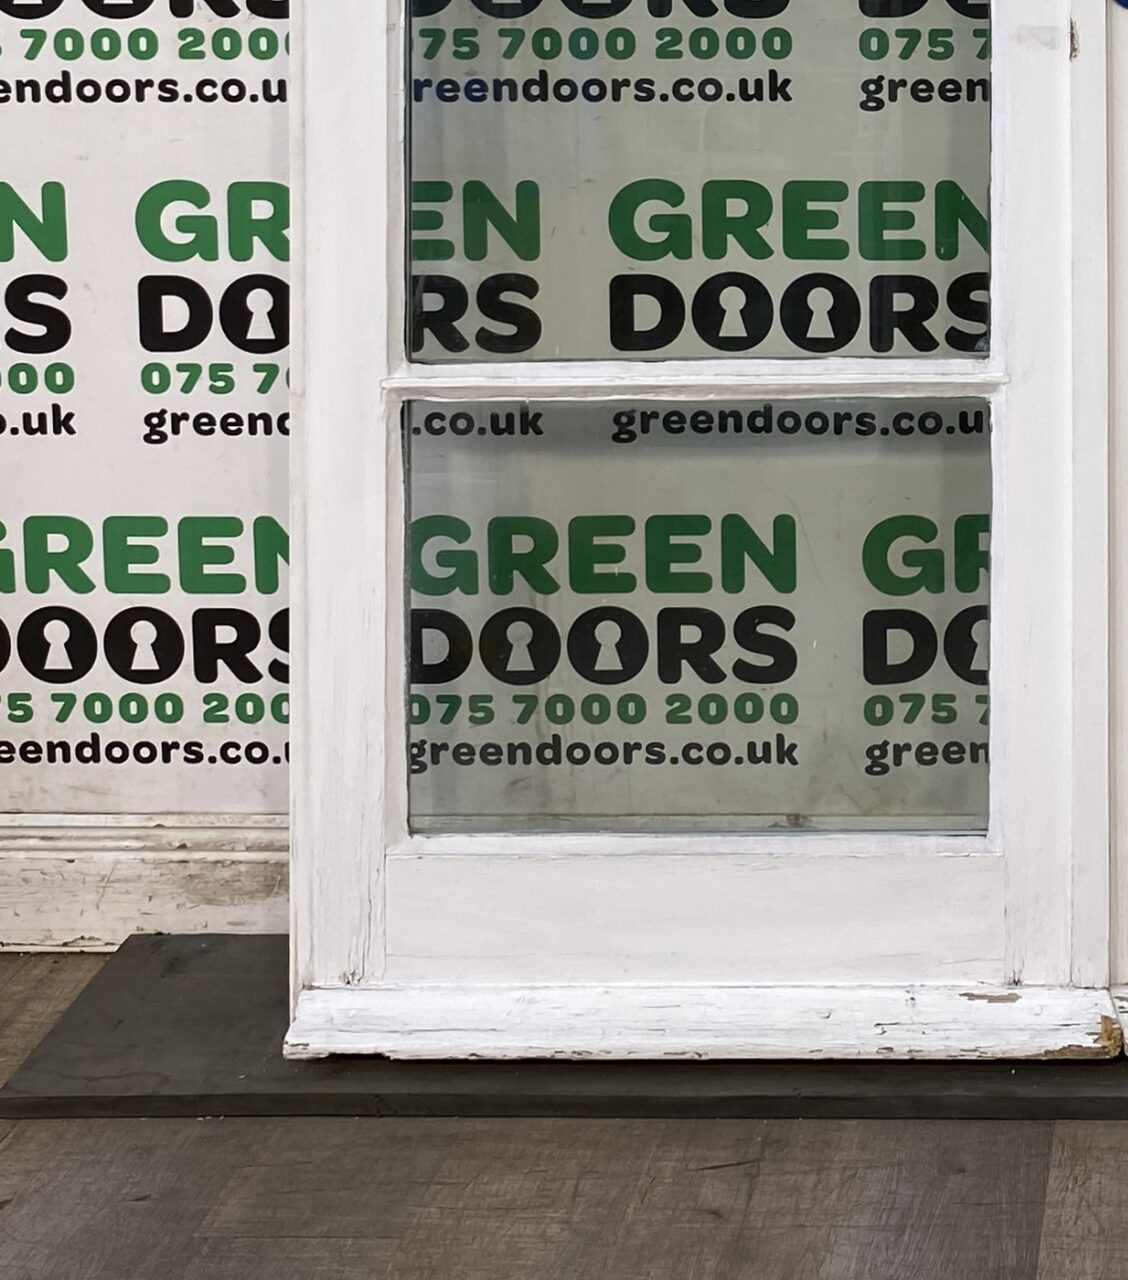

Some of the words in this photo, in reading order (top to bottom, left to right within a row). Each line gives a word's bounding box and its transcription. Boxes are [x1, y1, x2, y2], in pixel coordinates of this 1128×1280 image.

[21, 28, 159, 61] 7000
[178, 28, 289, 61] 200
[420, 27, 480, 61] 75
[501, 27, 636, 61] 7000
[656, 27, 792, 61] 2000
[859, 28, 955, 61] 075
[414, 70, 792, 104] reendoors.co.uk
[141, 362, 235, 395] 075
[611, 403, 990, 445] greendoors.co.u
[411, 514, 797, 596] GREEN
[411, 605, 798, 685] DOORS
[54, 693, 184, 724] 7000
[513, 693, 646, 724] 7000
[665, 692, 798, 724] 2000
[864, 695, 958, 726] 075
